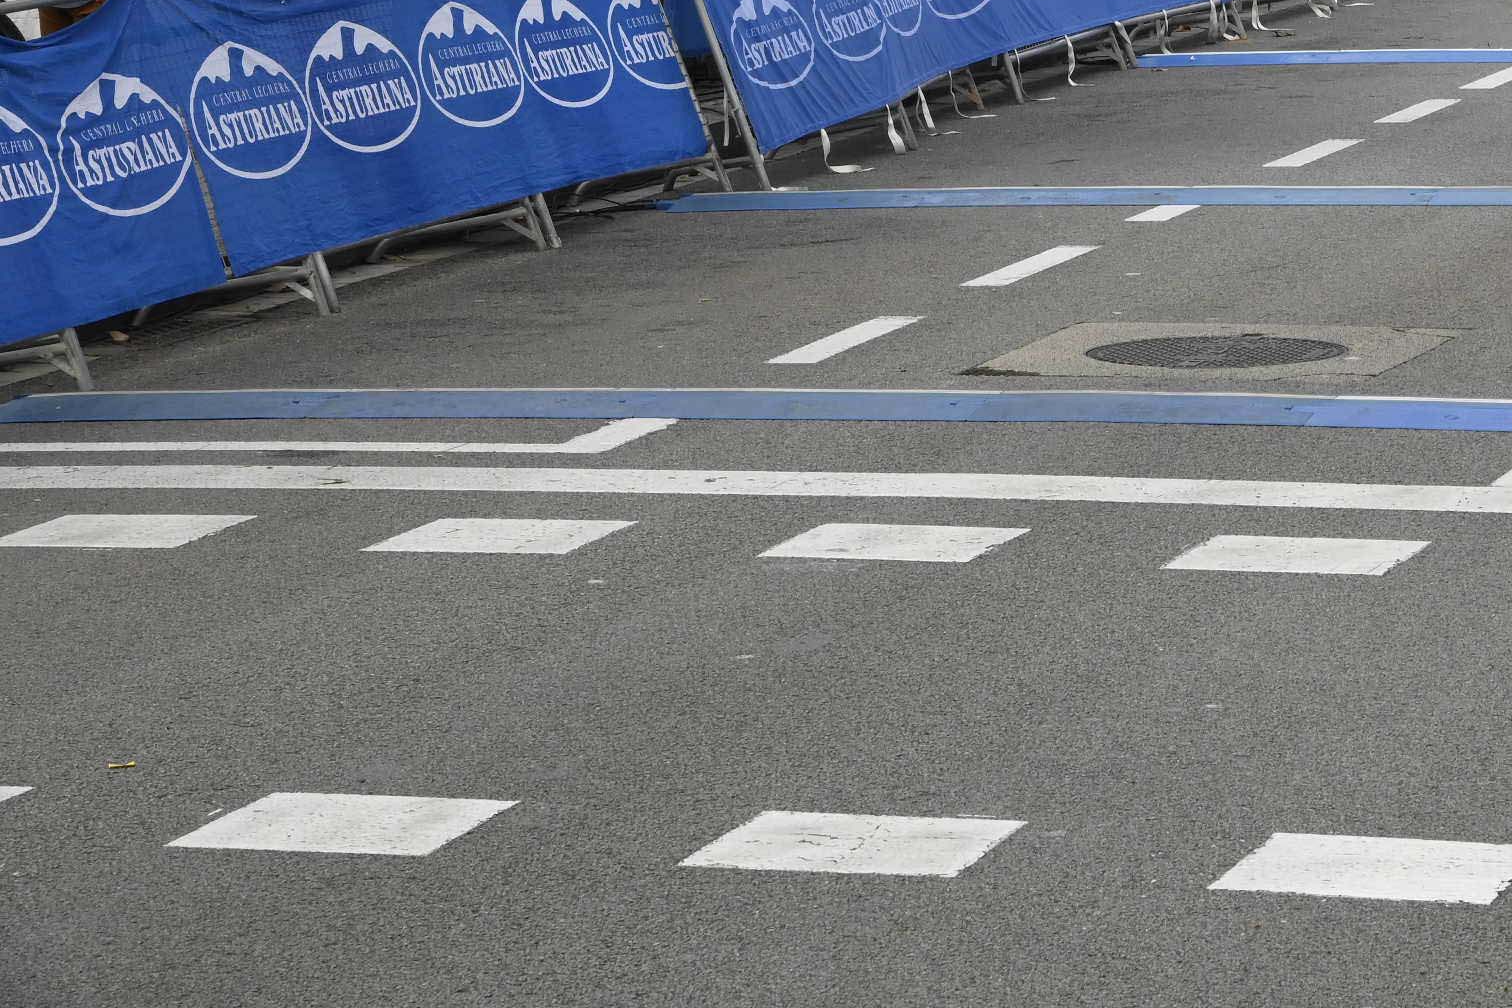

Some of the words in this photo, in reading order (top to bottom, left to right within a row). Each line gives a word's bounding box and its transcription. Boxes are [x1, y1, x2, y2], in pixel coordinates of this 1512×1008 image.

[438, 45, 472, 60] CENTRAL
[524, 37, 609, 82] ASTURIANA
[326, 67, 362, 84] CENTRAL
[364, 58, 400, 76] LECHERA
[428, 52, 520, 101] ASTURIANA
[212, 88, 250, 107] CENTRAL
[253, 80, 291, 98] LECHERA
[315, 75, 417, 126] ASTURIANA
[80, 120, 124, 142] CENTRAL
[201, 99, 306, 152] ASTURIANA
